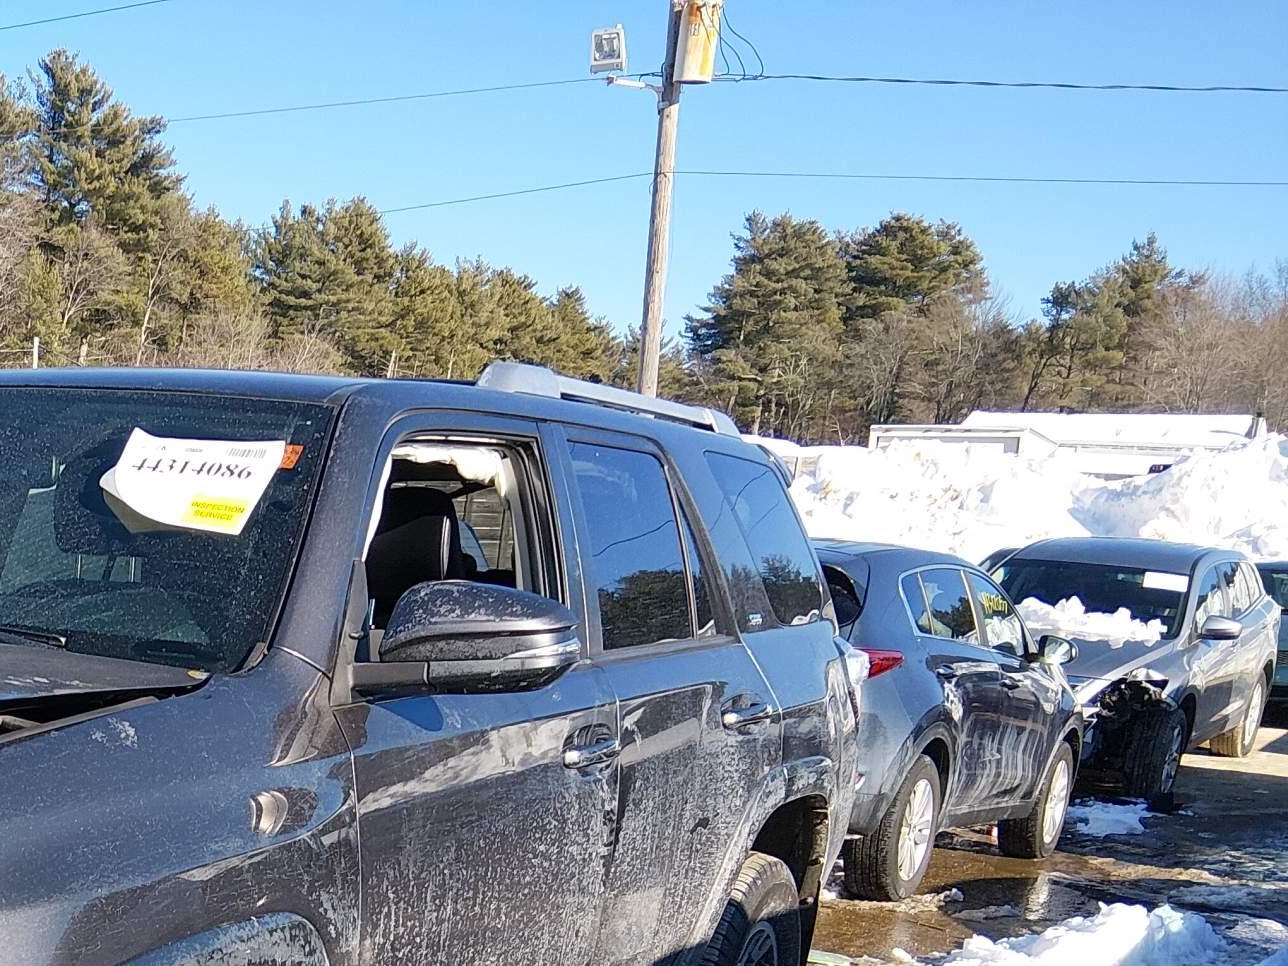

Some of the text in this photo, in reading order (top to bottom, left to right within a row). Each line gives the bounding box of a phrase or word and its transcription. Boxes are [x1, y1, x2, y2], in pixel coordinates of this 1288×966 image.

[131, 457, 254, 480] 44314086
[191, 501, 246, 515] INSPECTION
[192, 510, 234, 521] SERVICE
